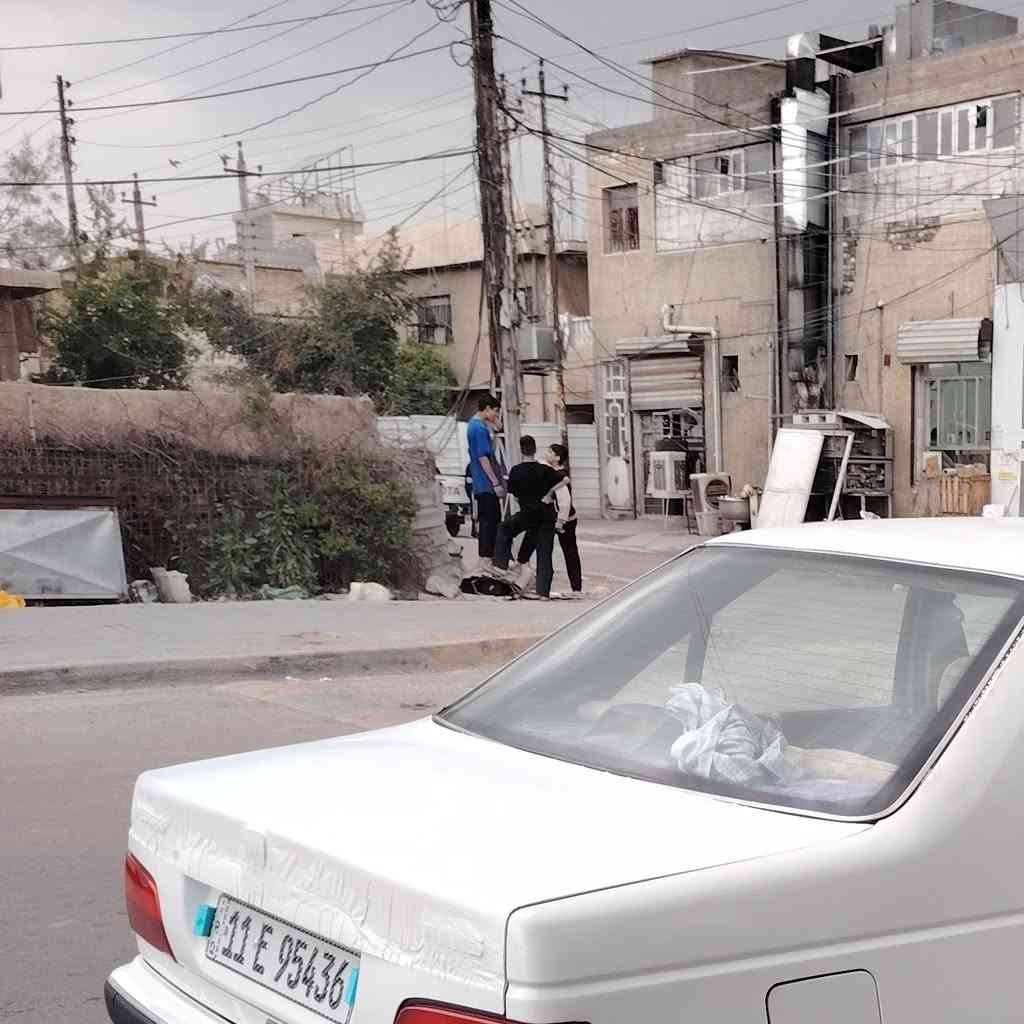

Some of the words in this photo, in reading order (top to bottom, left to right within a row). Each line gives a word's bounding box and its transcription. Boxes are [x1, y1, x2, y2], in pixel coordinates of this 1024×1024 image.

[221, 911, 252, 966] 11
[252, 924, 274, 976] E
[274, 934, 350, 1010] 95436
